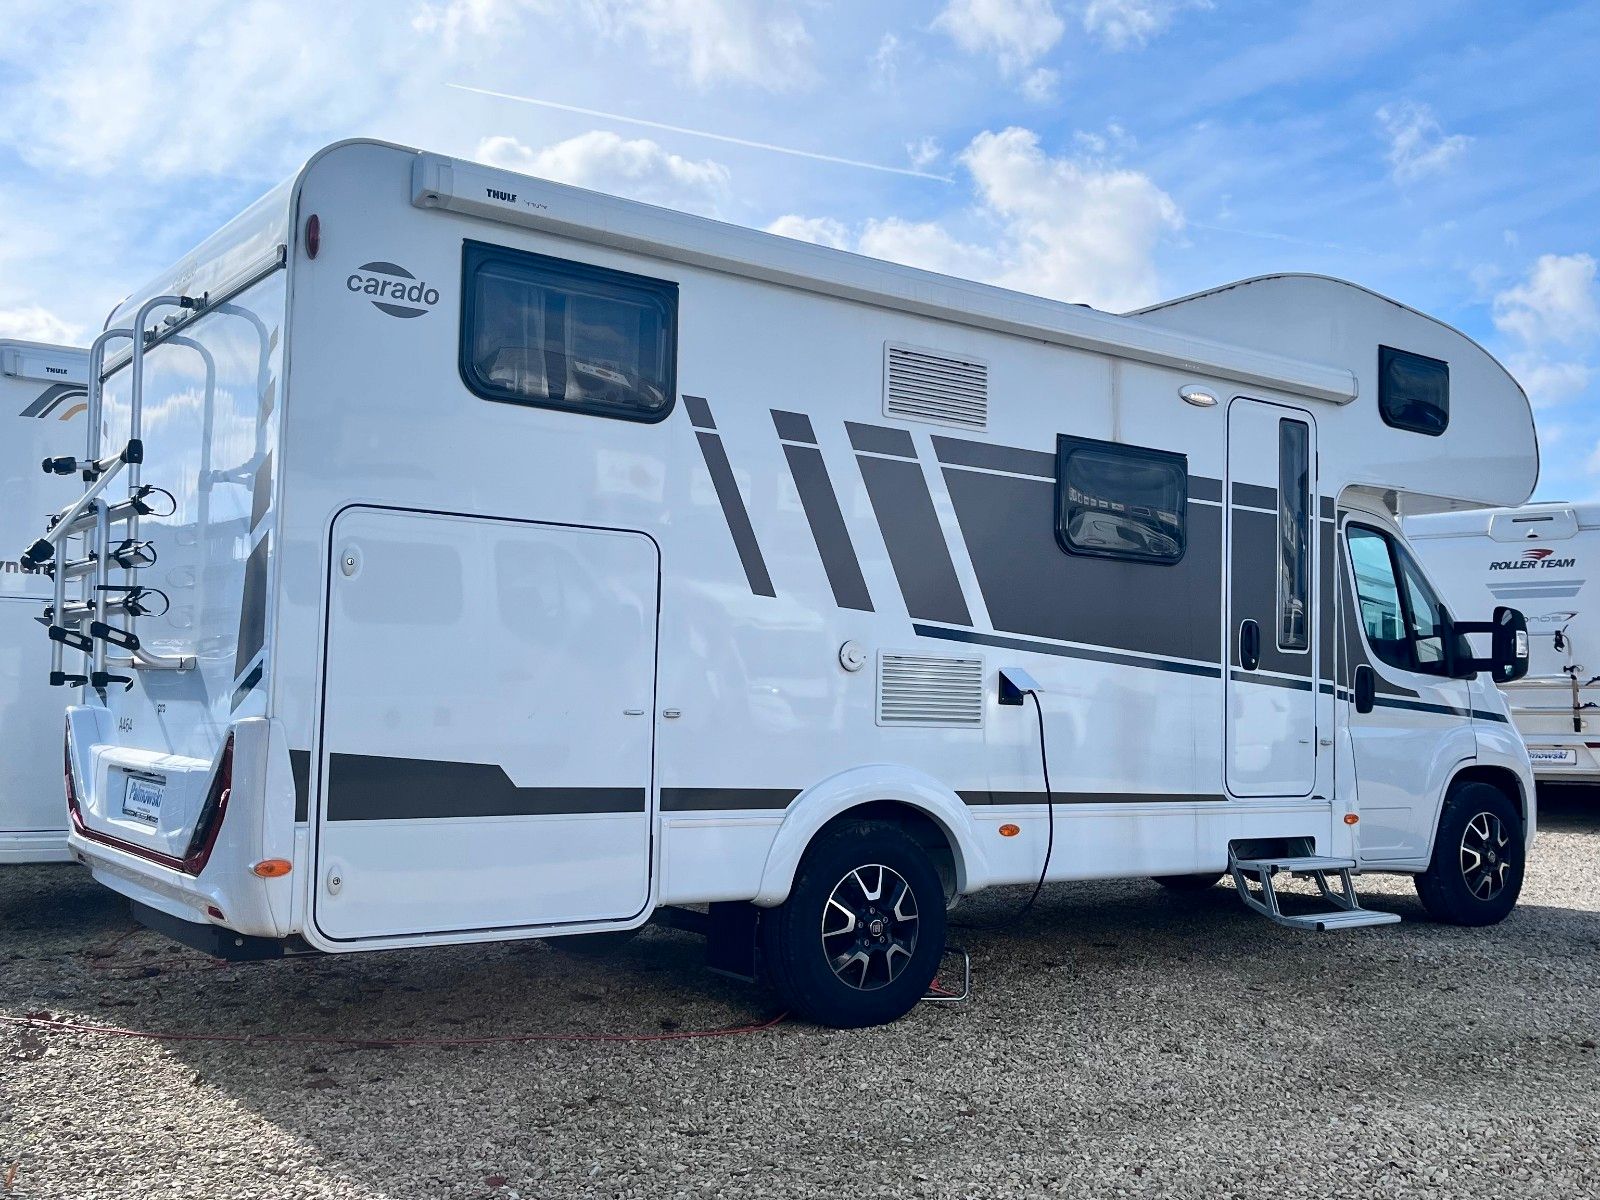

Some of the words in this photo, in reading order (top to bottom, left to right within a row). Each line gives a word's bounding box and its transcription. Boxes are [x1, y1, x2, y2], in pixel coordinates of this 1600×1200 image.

[486, 188, 518, 203] THULE
[346, 274, 440, 305] carado
[45, 366, 68, 375] THULE
[1489, 560, 1538, 571] ROLLER
[1541, 558, 1576, 569] TEAM
